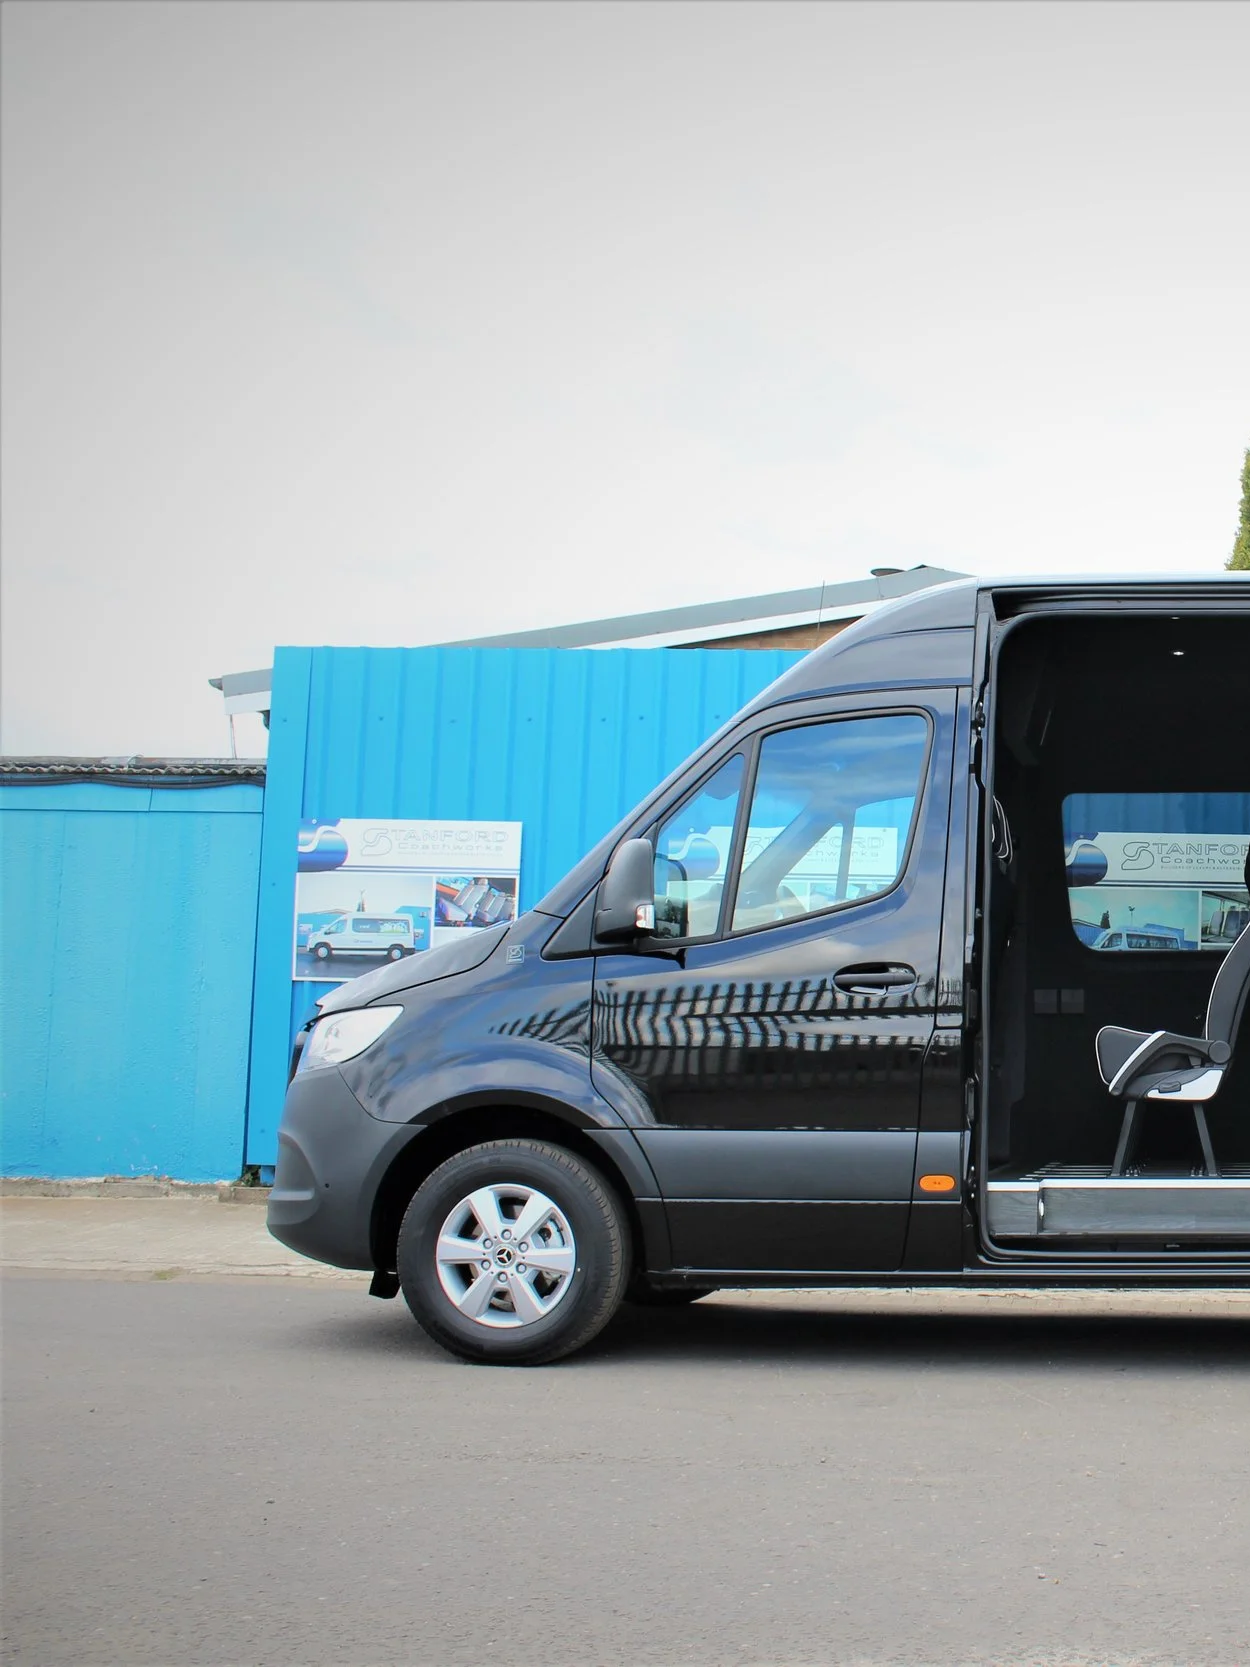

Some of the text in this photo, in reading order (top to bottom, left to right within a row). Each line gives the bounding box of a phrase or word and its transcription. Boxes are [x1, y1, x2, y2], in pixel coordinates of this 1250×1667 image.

[361, 827, 509, 857] STANFORD
[1121, 841, 1250, 871] STANFO
[1160, 856, 1246, 865] Coachwo
